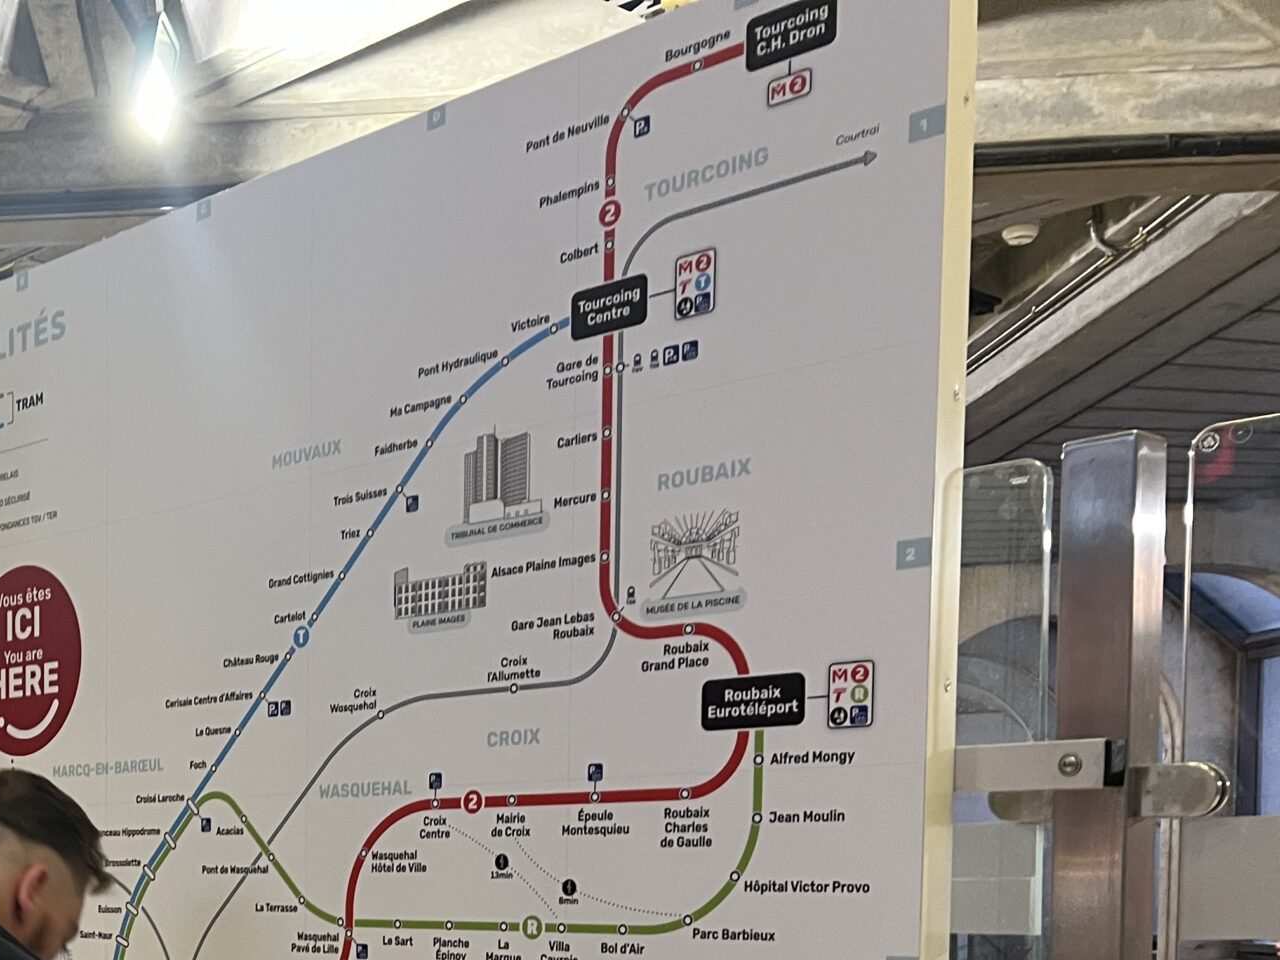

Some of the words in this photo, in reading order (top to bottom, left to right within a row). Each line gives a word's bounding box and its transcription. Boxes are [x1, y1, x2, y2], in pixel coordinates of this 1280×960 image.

[755, 5, 828, 41] Tourcoing
[665, 30, 731, 62] Bourgogne
[757, 36, 786, 56] C.H.
[789, 23, 826, 44] Dron
[526, 136, 550, 153] Pont
[552, 130, 565, 143] de
[567, 114, 610, 139] Neuville
[835, 123, 880, 146] Courtrai
[645, 147, 769, 200] TOURCOING
[539, 180, 600, 208] Phalempins
[603, 204, 616, 222] 2
[560, 243, 599, 264] Colbert
[578, 287, 641, 314] Tourcoing
[511, 314, 550, 333] Victoire
[587, 305, 631, 326] Centre
[418, 365, 439, 378] Pont
[441, 349, 498, 373] Hydraulique
[557, 359, 582, 373] Gare
[585, 354, 599, 367] de
[546, 369, 599, 390] Tourcoing
[390, 405, 403, 418] Ma
[404, 394, 452, 415] Campagne
[375, 438, 418, 456] Faidherbe
[557, 432, 598, 448] Carliers
[272, 438, 342, 469] MOUVAUX
[657, 457, 752, 491] ROUBAIX
[333, 494, 353, 506] Trois
[355, 488, 388, 502] Suisses
[554, 492, 597, 508] Mercure
[451, 526, 486, 540] TRIBUNAL
[487, 524, 498, 534] DE
[499, 517, 543, 533] COMMERCE
[491, 563, 524, 578] Alsace
[526, 559, 556, 574] Plaine
[558, 553, 596, 570] Images
[269, 577, 291, 589] Grand
[293, 569, 334, 585] Cottignies
[26, 587, 51, 603] êtes
[646, 602, 676, 615] MUSÉE
[677, 602, 689, 612] DE
[691, 600, 703, 611] LA
[705, 595, 741, 609] PISCINE
[6, 605, 40, 642] ICI
[274, 611, 306, 624] Cartelot
[511, 619, 535, 632] Gare
[537, 616, 562, 629] Jean
[564, 611, 595, 625] Lebas
[553, 625, 595, 640] Roubaix
[4, 650, 23, 665] You
[25, 648, 43, 662] are
[663, 641, 709, 656] Roubaix
[223, 655, 253, 668] Château
[255, 652, 279, 665] Rouge
[500, 655, 528, 668] Croix
[641, 659, 675, 673] Grand
[677, 655, 709, 669] Place
[354, 687, 377, 699] Croix
[724, 686, 782, 703] Roubaix
[330, 699, 377, 714] Wasquehal
[707, 699, 799, 720] Eurotéléport
[487, 728, 541, 748] CROIX
[52, 757, 164, 778] MARCQ-EN-BARŒUL
[770, 751, 809, 766] Alfred
[812, 750, 855, 767] Mongy
[319, 780, 412, 800] WASQUEHAL
[468, 794, 478, 809] 2
[423, 814, 447, 827] Croix
[496, 812, 526, 824] Mairie
[577, 808, 614, 823] Épeule
[664, 806, 710, 819] Roubaix
[769, 810, 800, 824] Jean
[803, 809, 845, 823] Moulin
[216, 827, 244, 837] Acacias
[419, 828, 451, 840] Centre
[561, 824, 630, 838] Montesquieu
[665, 821, 708, 834] Charles
[371, 850, 418, 862] Wasquehal
[744, 880, 788, 896] Hôpital
[791, 880, 829, 893] Victor
[832, 881, 870, 894] Provo
[526, 919, 538, 936] R
[692, 927, 719, 941] Parc
[721, 927, 775, 943] Barbieux
[297, 932, 340, 944] Wasquehal
[433, 937, 470, 949] Planche
